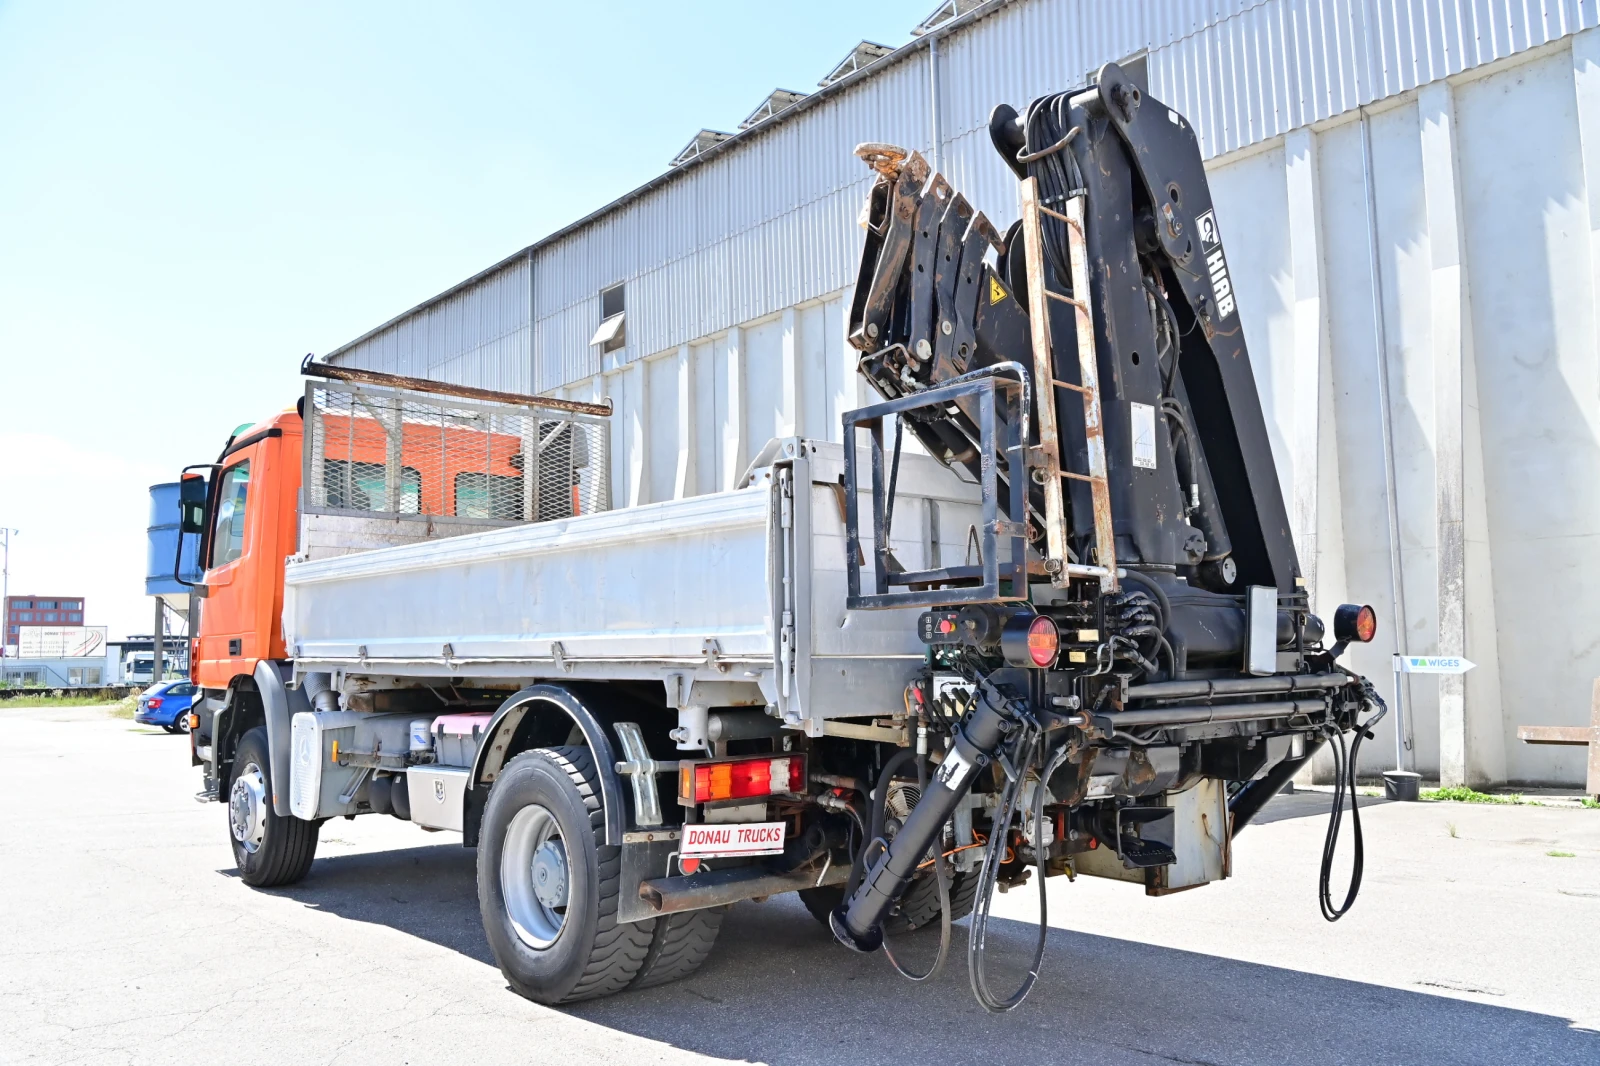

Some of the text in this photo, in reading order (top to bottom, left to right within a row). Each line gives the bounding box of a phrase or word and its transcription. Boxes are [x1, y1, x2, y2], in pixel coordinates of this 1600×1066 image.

[1206, 250, 1235, 317] HIAB
[1428, 659, 1460, 667] WIGES
[688, 828, 781, 845] DONAU TRUCKS
